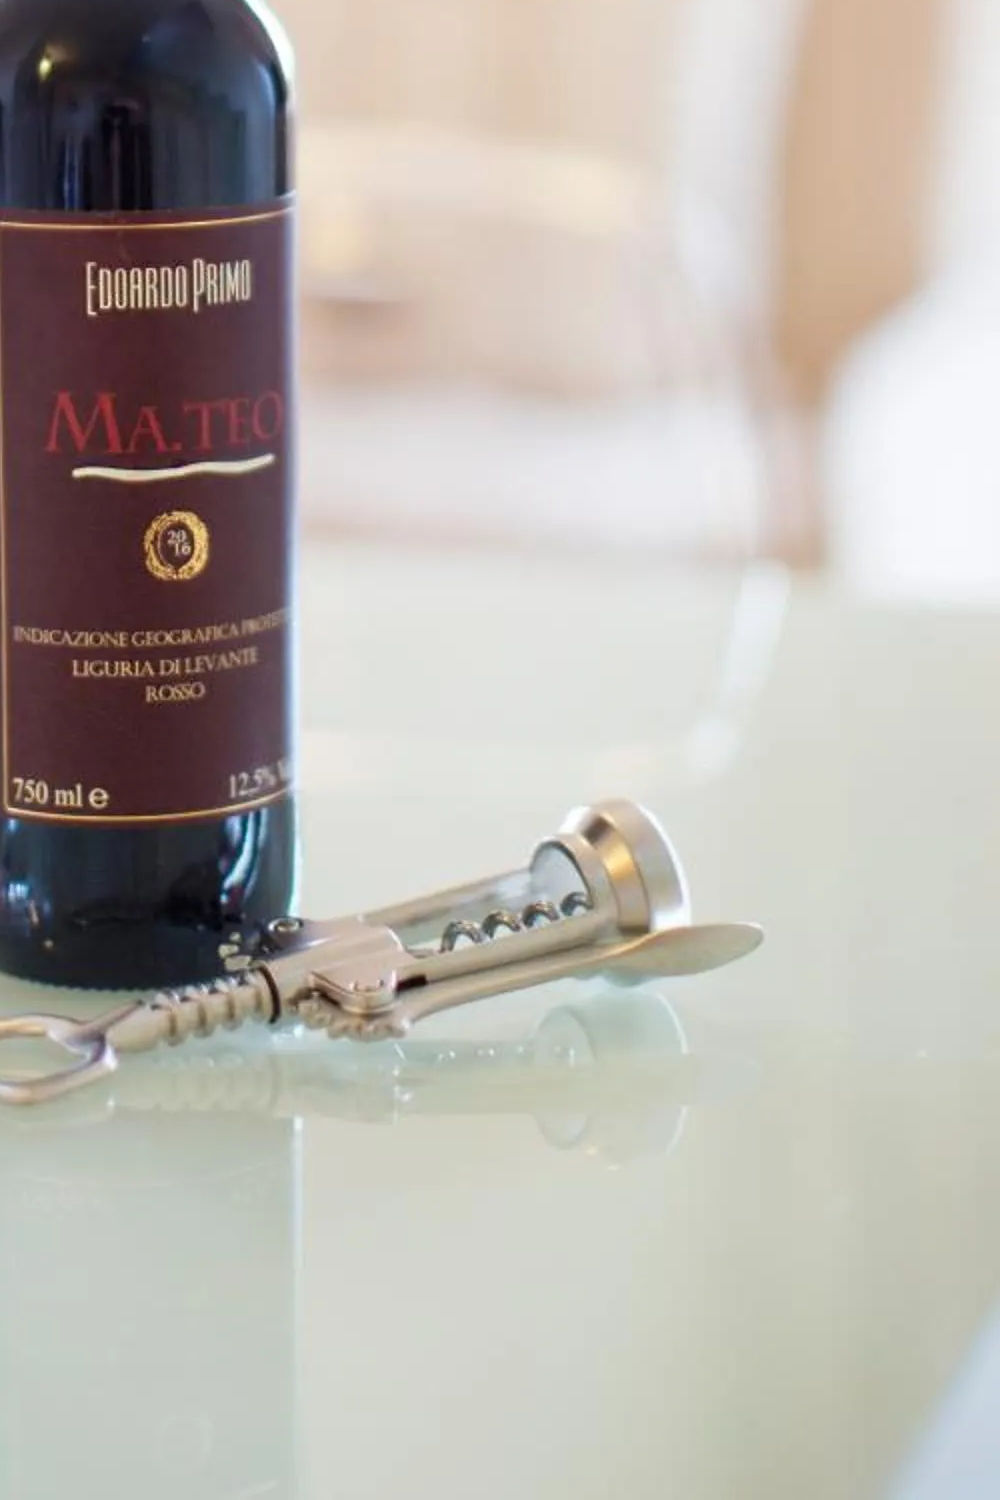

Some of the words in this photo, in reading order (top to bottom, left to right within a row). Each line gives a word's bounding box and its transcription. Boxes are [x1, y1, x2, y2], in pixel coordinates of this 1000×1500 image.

[86, 261, 188, 316] EDOARDO
[192, 258, 251, 313] PRIMO
[44, 389, 284, 453] MA.TEO
[13, 625, 129, 648] INDICAZIONE
[131, 623, 240, 647] GEOGRAFICA
[72, 659, 154, 678] LIGURIA
[159, 659, 180, 676] DI
[184, 646, 259, 674] LEVANTE
[145, 681, 206, 703] ROSSO
[12, 777, 49, 804] 750
[55, 783, 83, 808] ml
